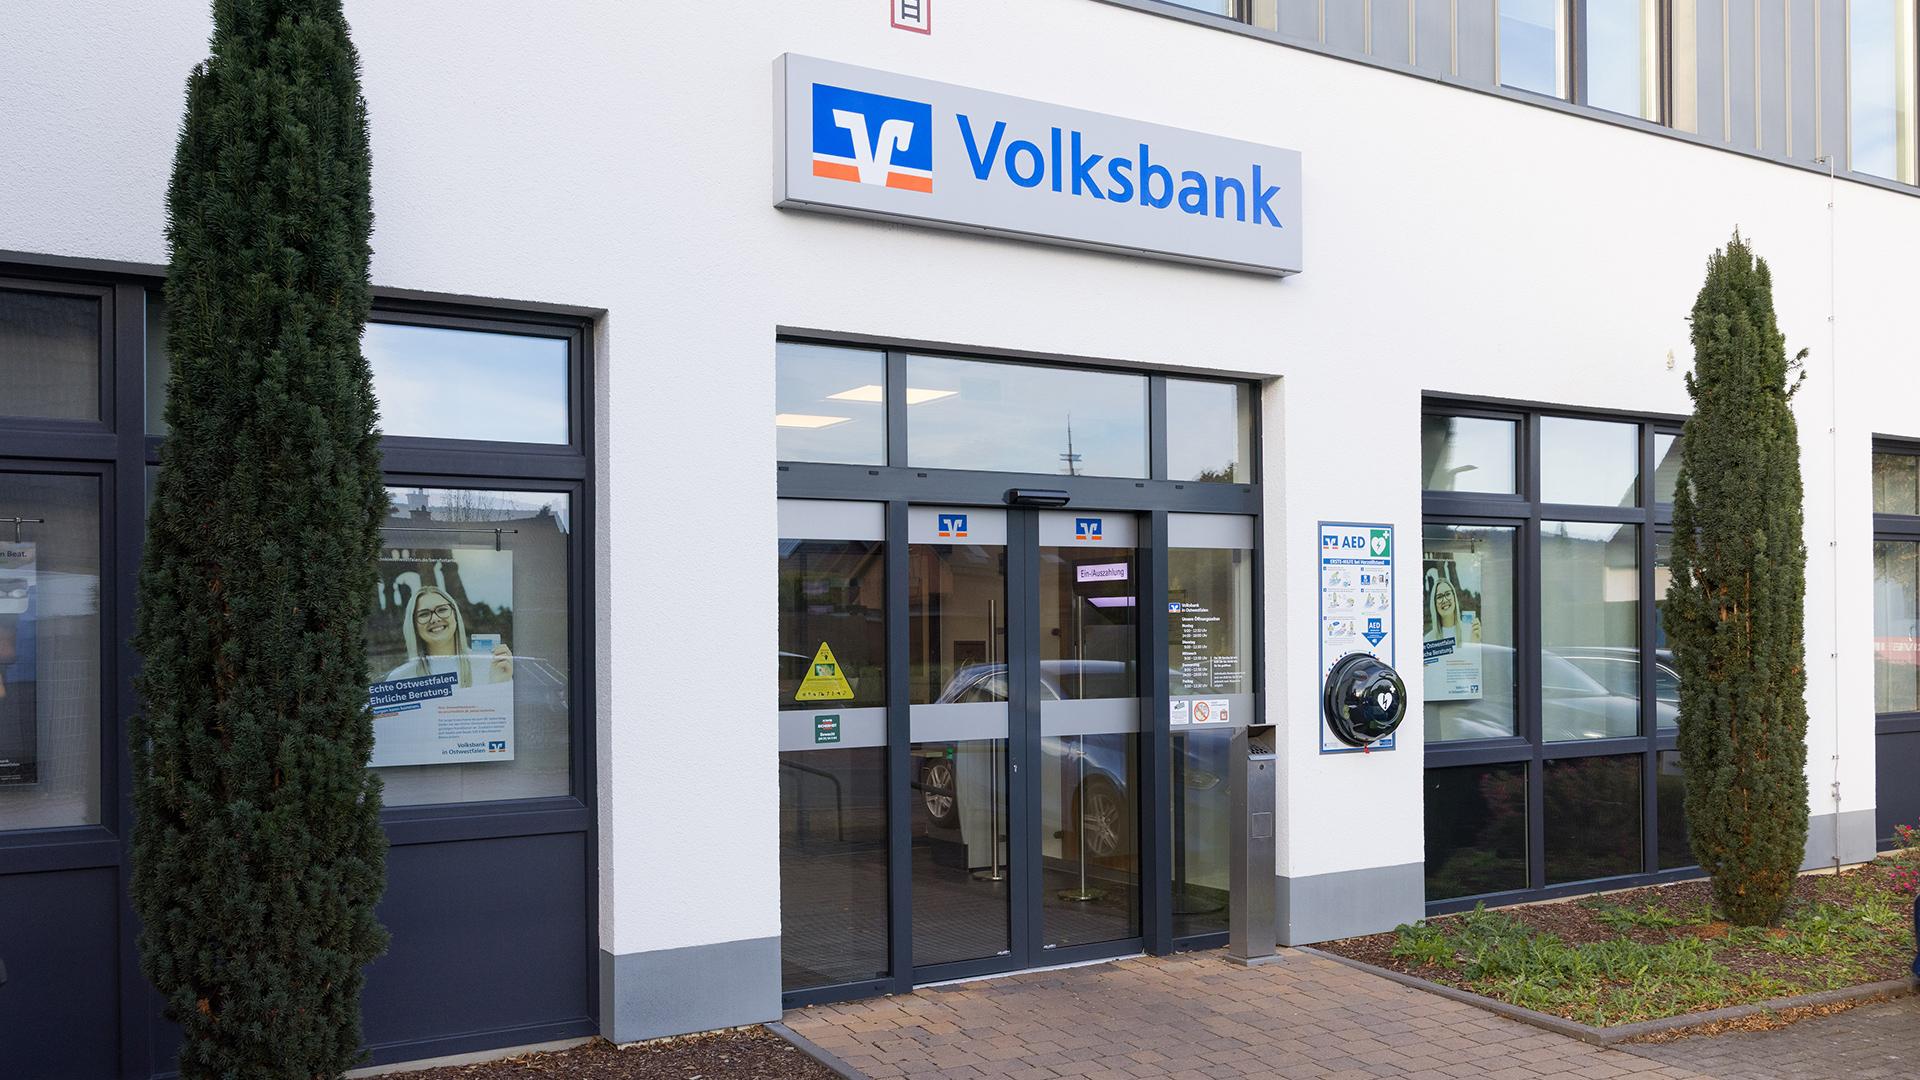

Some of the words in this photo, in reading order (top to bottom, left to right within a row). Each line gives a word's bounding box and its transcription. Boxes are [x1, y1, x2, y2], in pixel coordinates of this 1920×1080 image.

[955, 113, 1283, 228] Volksbank
[1342, 536, 1365, 548] AED
[1080, 568, 1125, 578] Ein-/Auszahlung
[369, 684, 394, 694] Echte
[396, 675, 458, 690] Ostwestfalen.
[370, 693, 407, 705] Ehrliche
[409, 687, 452, 700] Beratung.
[448, 747, 486, 755] Ostwestfalen
